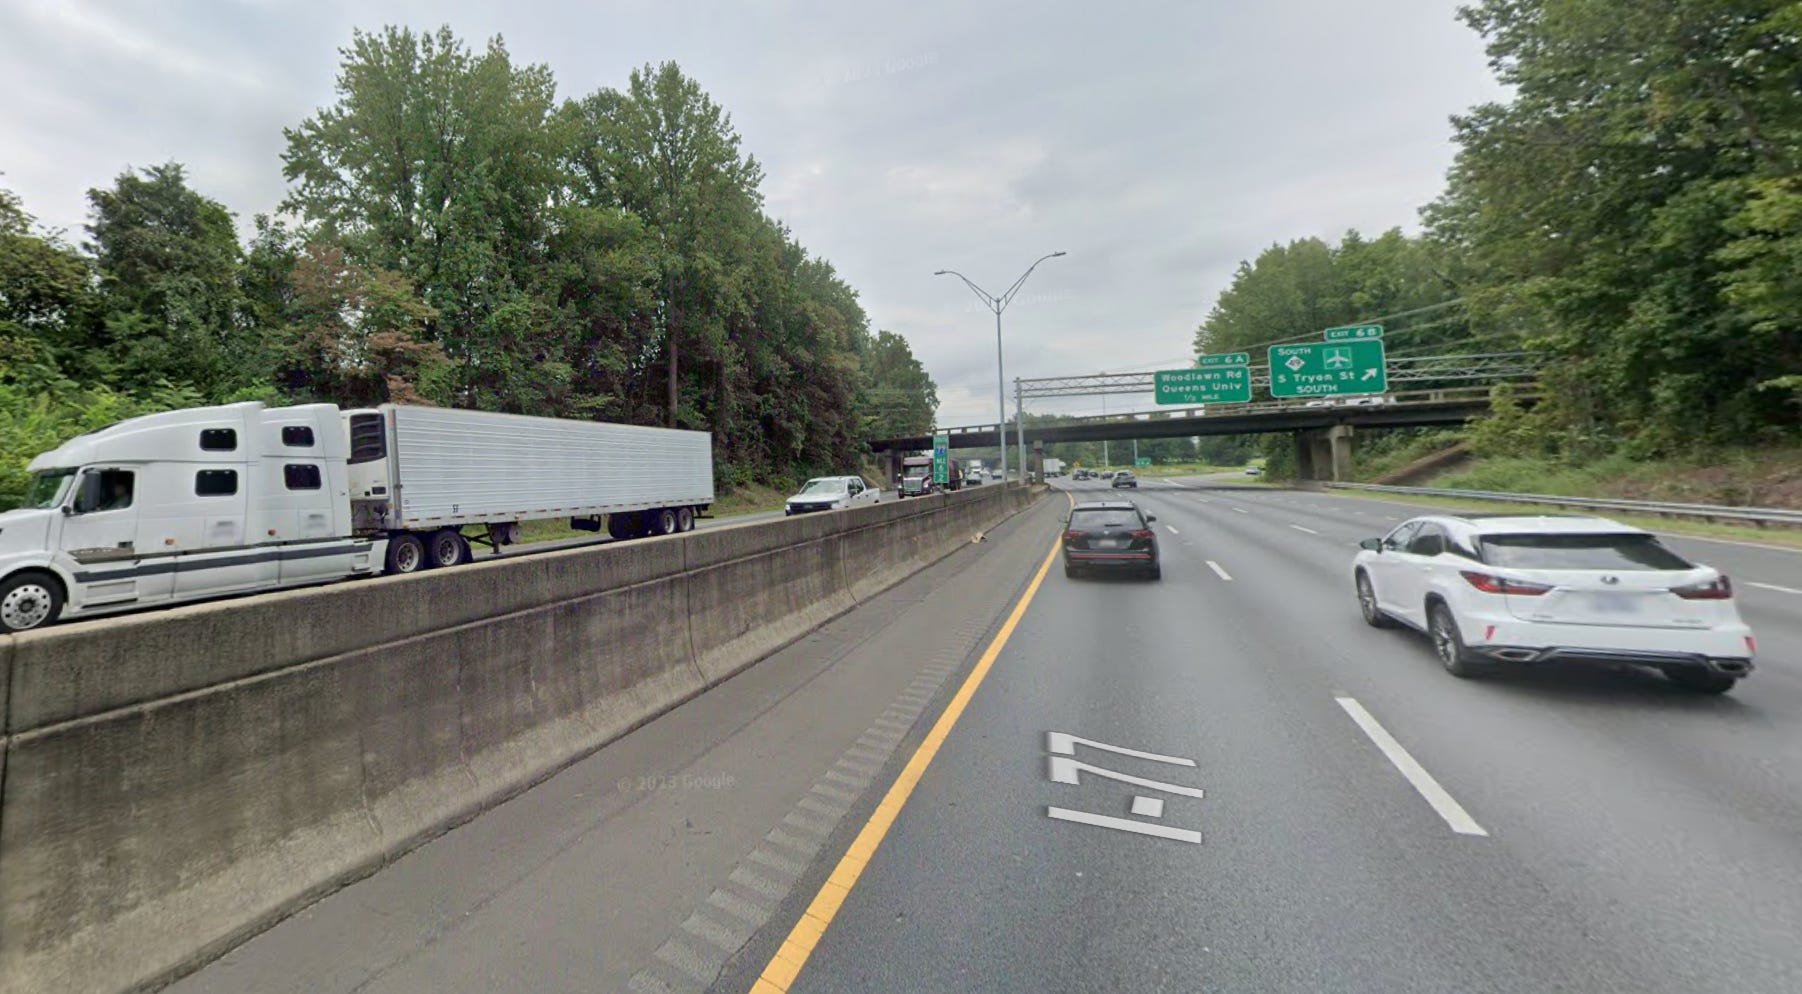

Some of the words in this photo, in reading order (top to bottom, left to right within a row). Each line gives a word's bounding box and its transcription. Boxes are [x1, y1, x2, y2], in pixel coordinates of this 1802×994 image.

[1278, 348, 1311, 356] SOUTH
[1235, 356, 1244, 364] A
[1161, 373, 1221, 382] Woodlawn
[1226, 370, 1242, 379] Rd
[1278, 374, 1286, 383] S
[1294, 373, 1333, 383] Tryon
[1339, 371, 1355, 380] St
[1162, 385, 1206, 393] Queens
[1296, 384, 1338, 393] SOUTH
[1048, 731, 1204, 844] I-77
